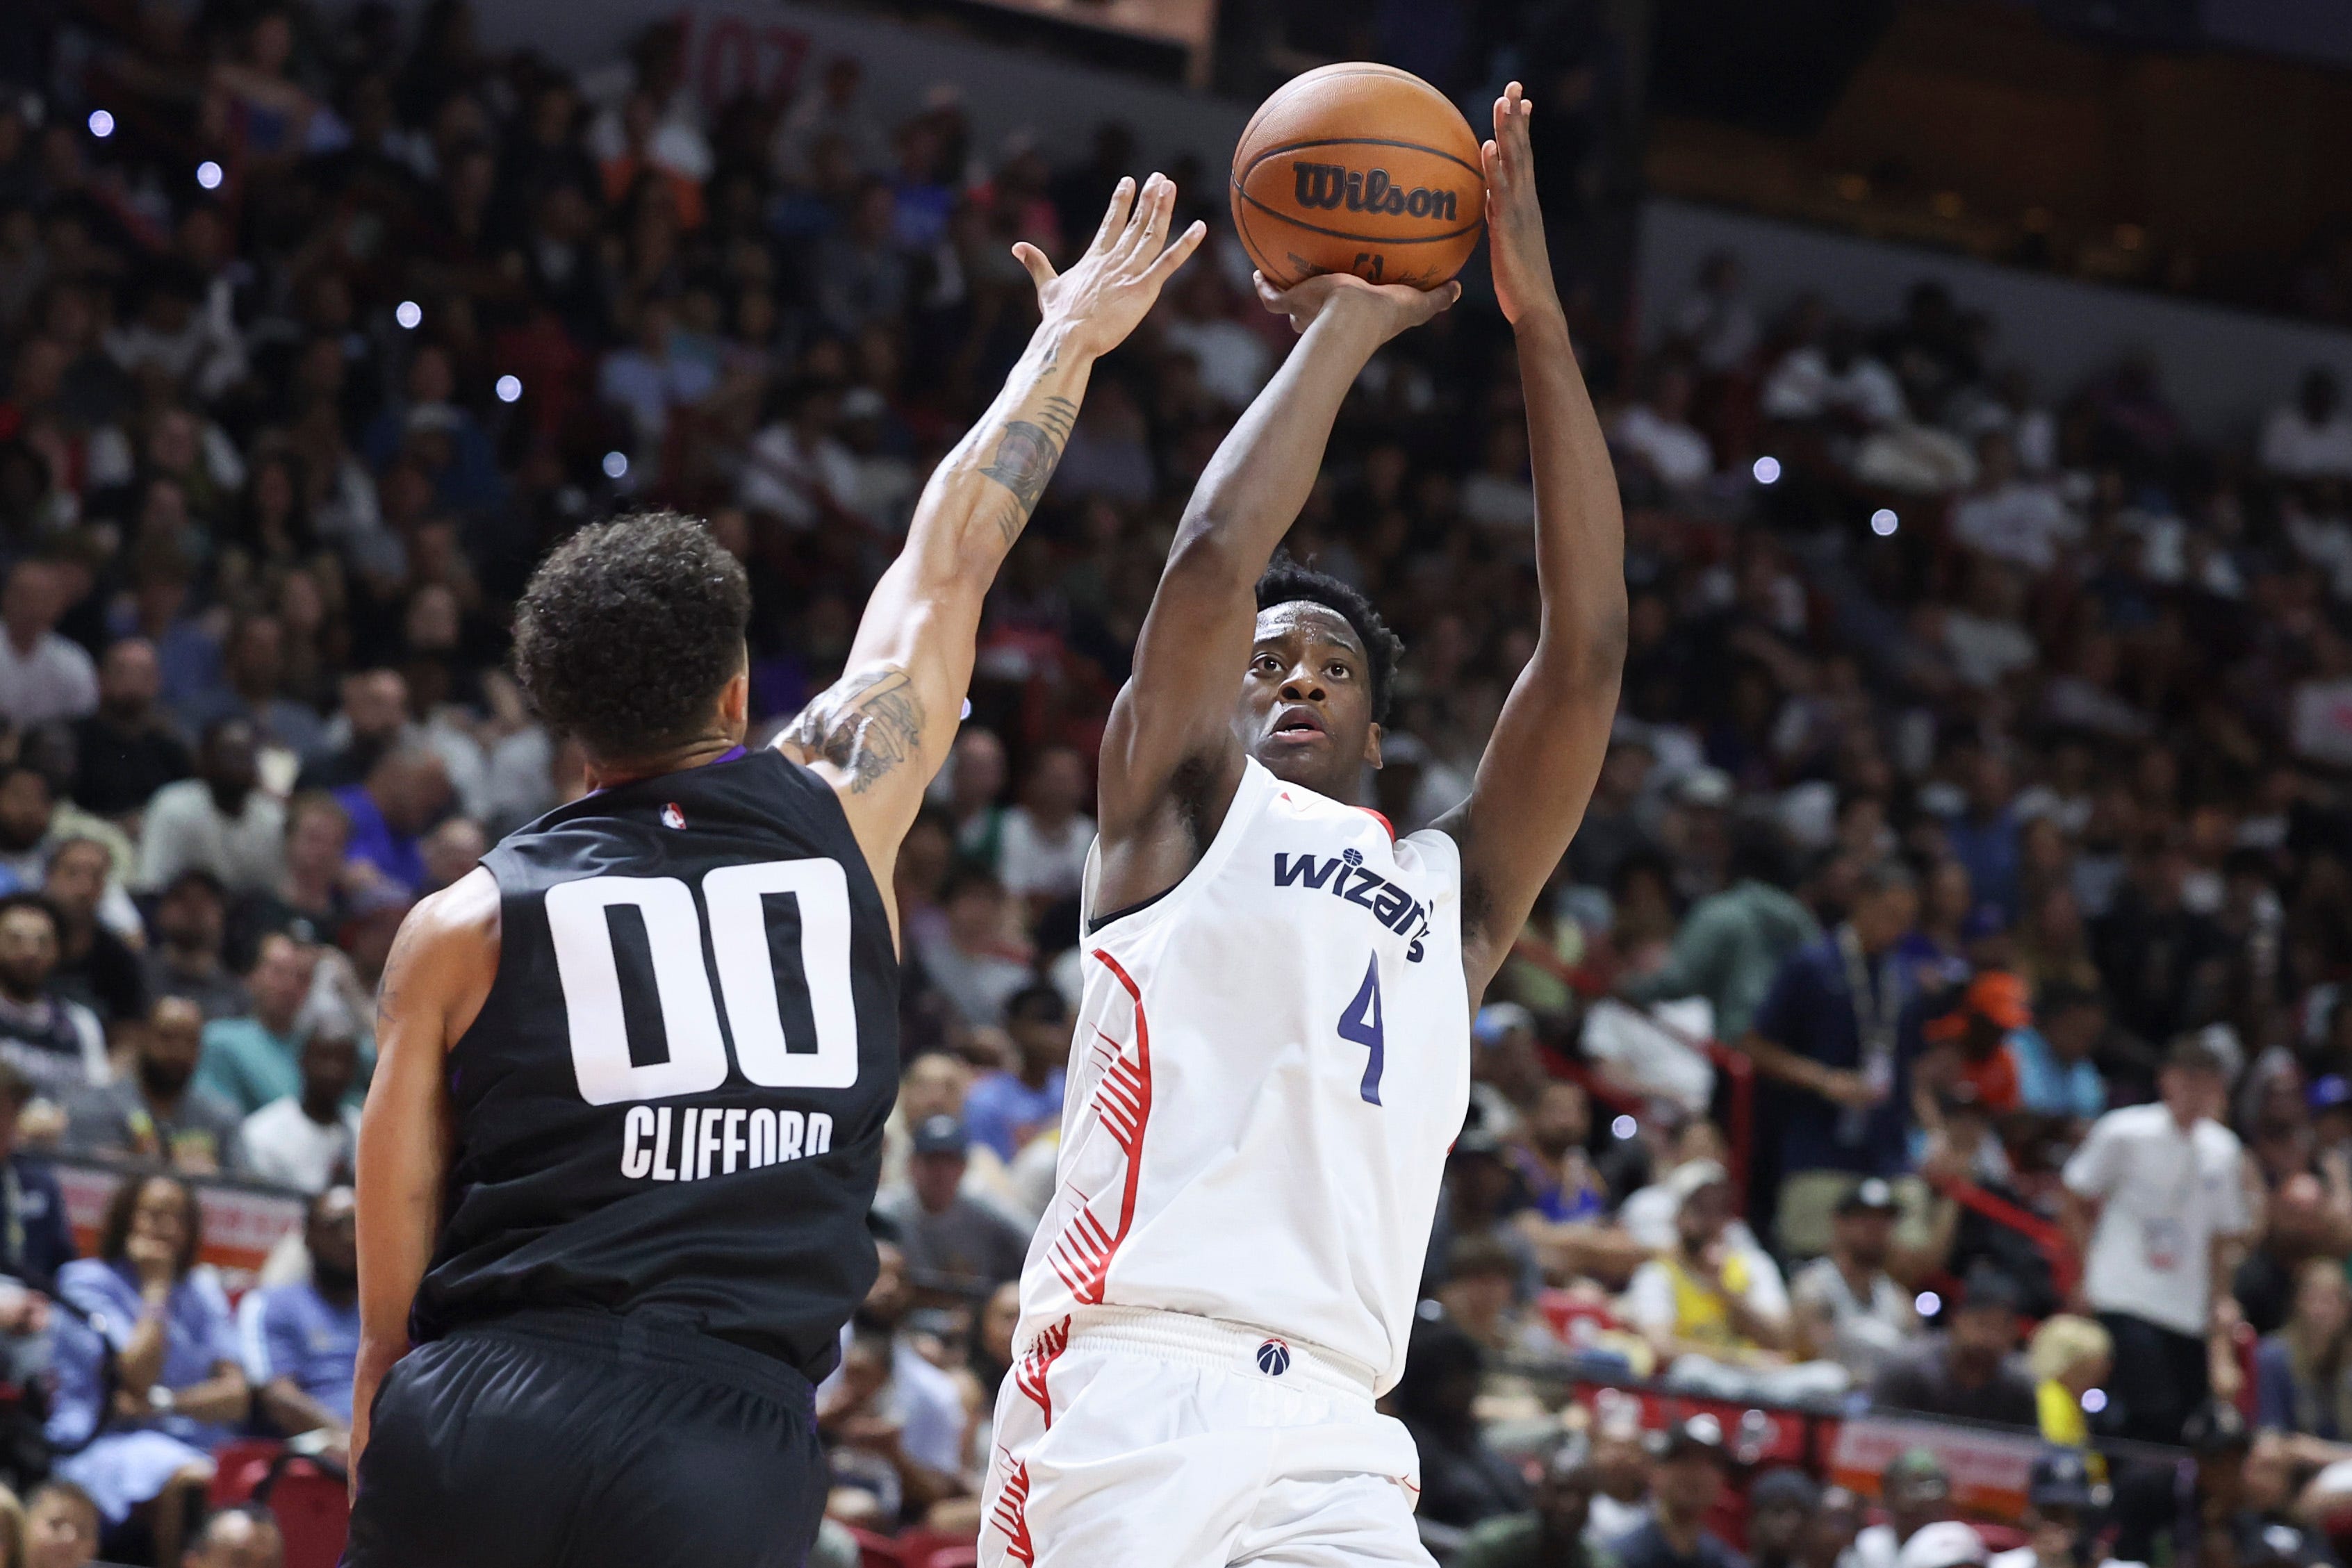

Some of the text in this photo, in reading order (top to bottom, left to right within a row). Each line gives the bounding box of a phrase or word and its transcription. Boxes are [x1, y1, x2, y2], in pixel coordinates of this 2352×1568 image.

[1293, 161, 1456, 221] Wilson
[1274, 848, 1434, 963] wizars
[545, 857, 858, 1106] 00
[1338, 948, 1384, 1107] 4
